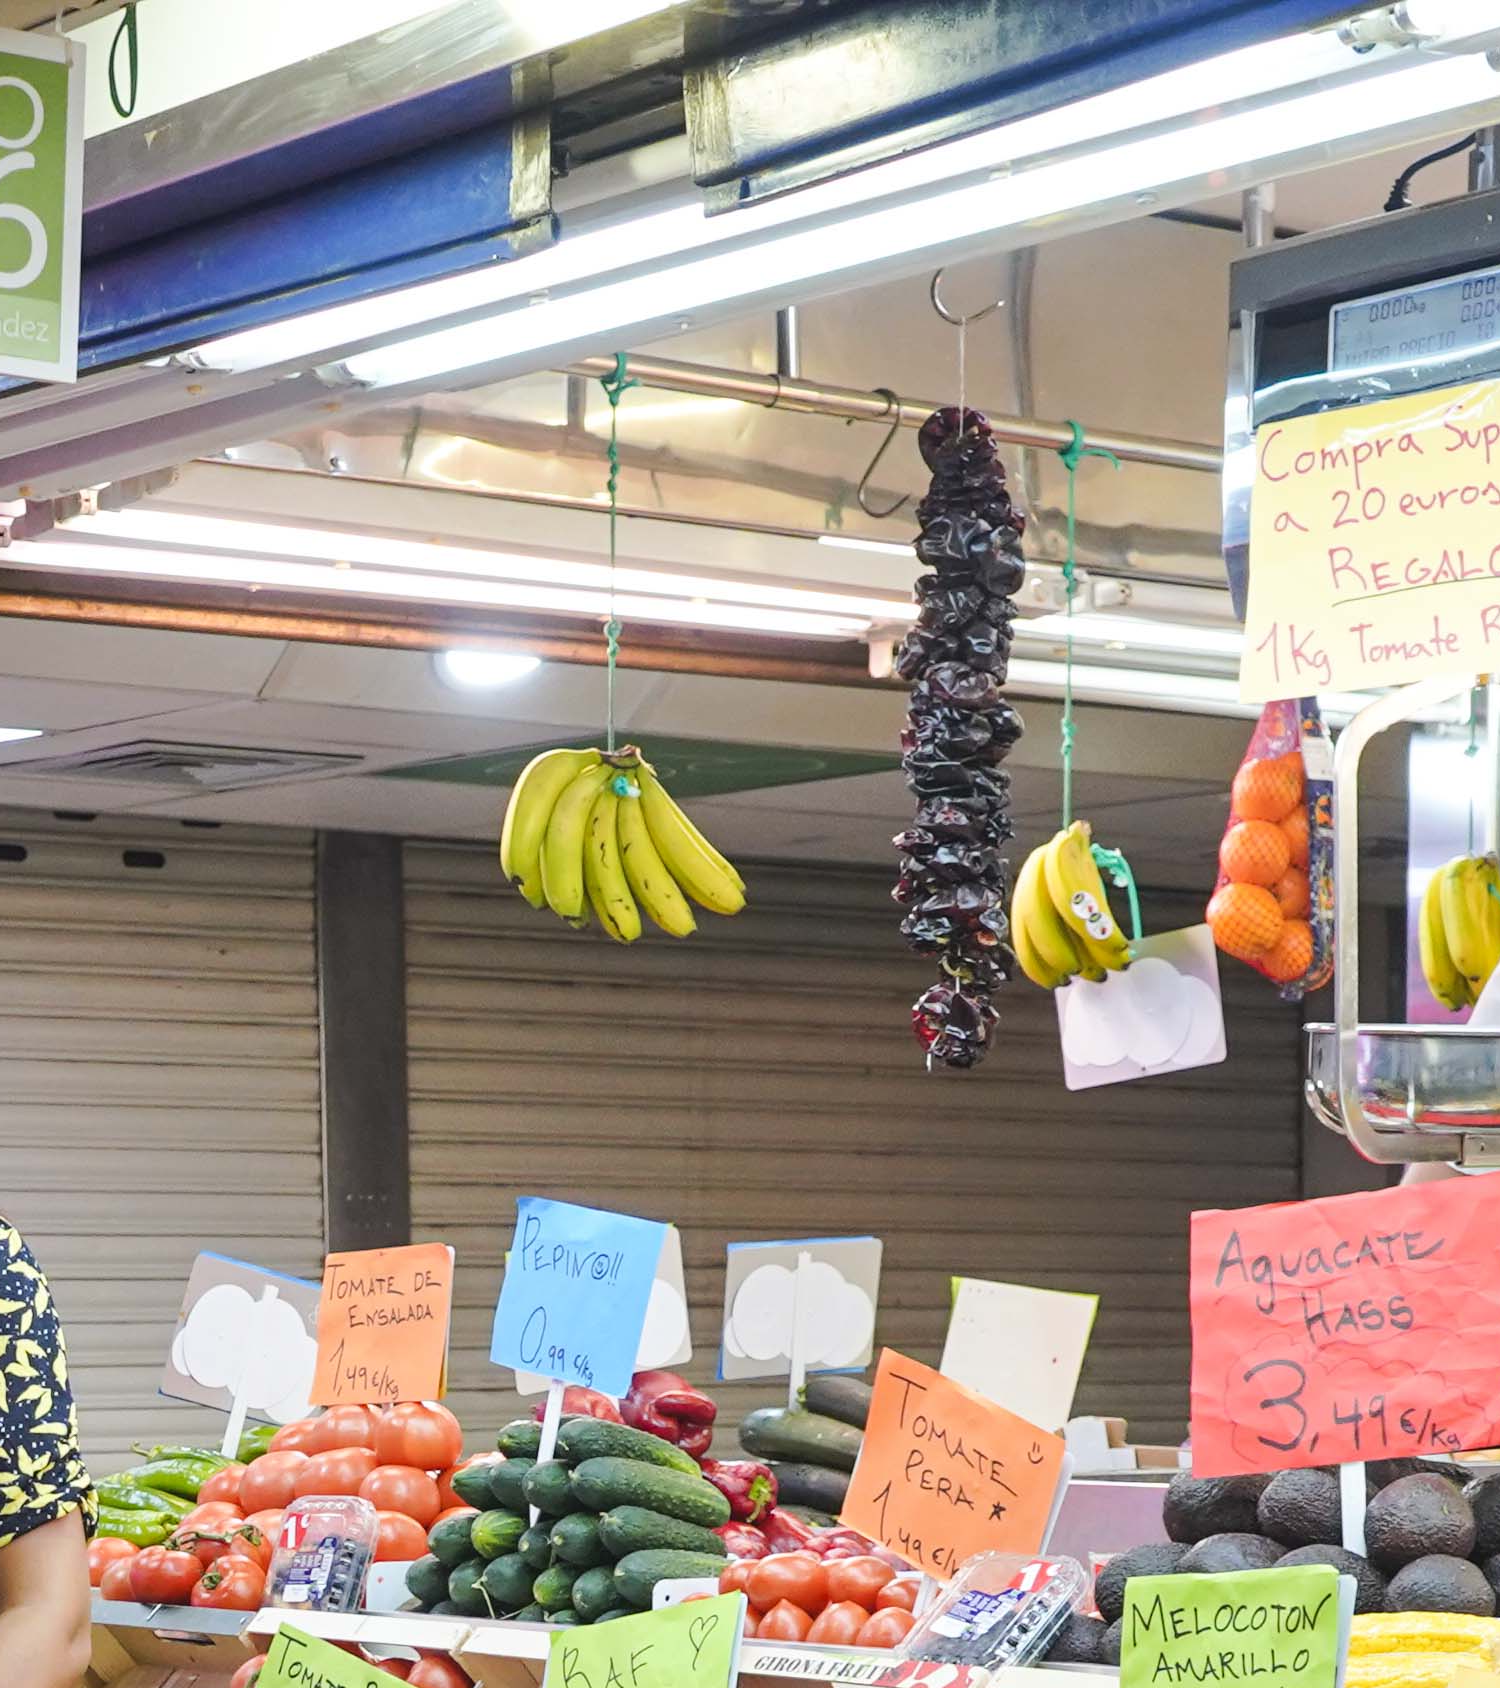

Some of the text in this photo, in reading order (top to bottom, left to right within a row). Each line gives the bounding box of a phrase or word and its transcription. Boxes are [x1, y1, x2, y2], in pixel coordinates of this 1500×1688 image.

[1261, 429, 1423, 489] Compra
[1274, 512, 1309, 532] a
[1332, 487, 1386, 529] 20
[1350, 615, 1460, 664] Tomate
[327, 1263, 443, 1302] TOMATE DE
[349, 1303, 435, 1329] ENSALADA
[518, 1305, 566, 1369] 0,99
[1301, 1290, 1414, 1344] HASS
[329, 1338, 369, 1399] 1,49
[1243, 1358, 1388, 1453] 3,49
[889, 1371, 1018, 1498] TOMATE
[904, 1448, 976, 1511] PERA
[752, 1655, 826, 1679] GIRONA
[1152, 1648, 1310, 1683] AMARILLO
